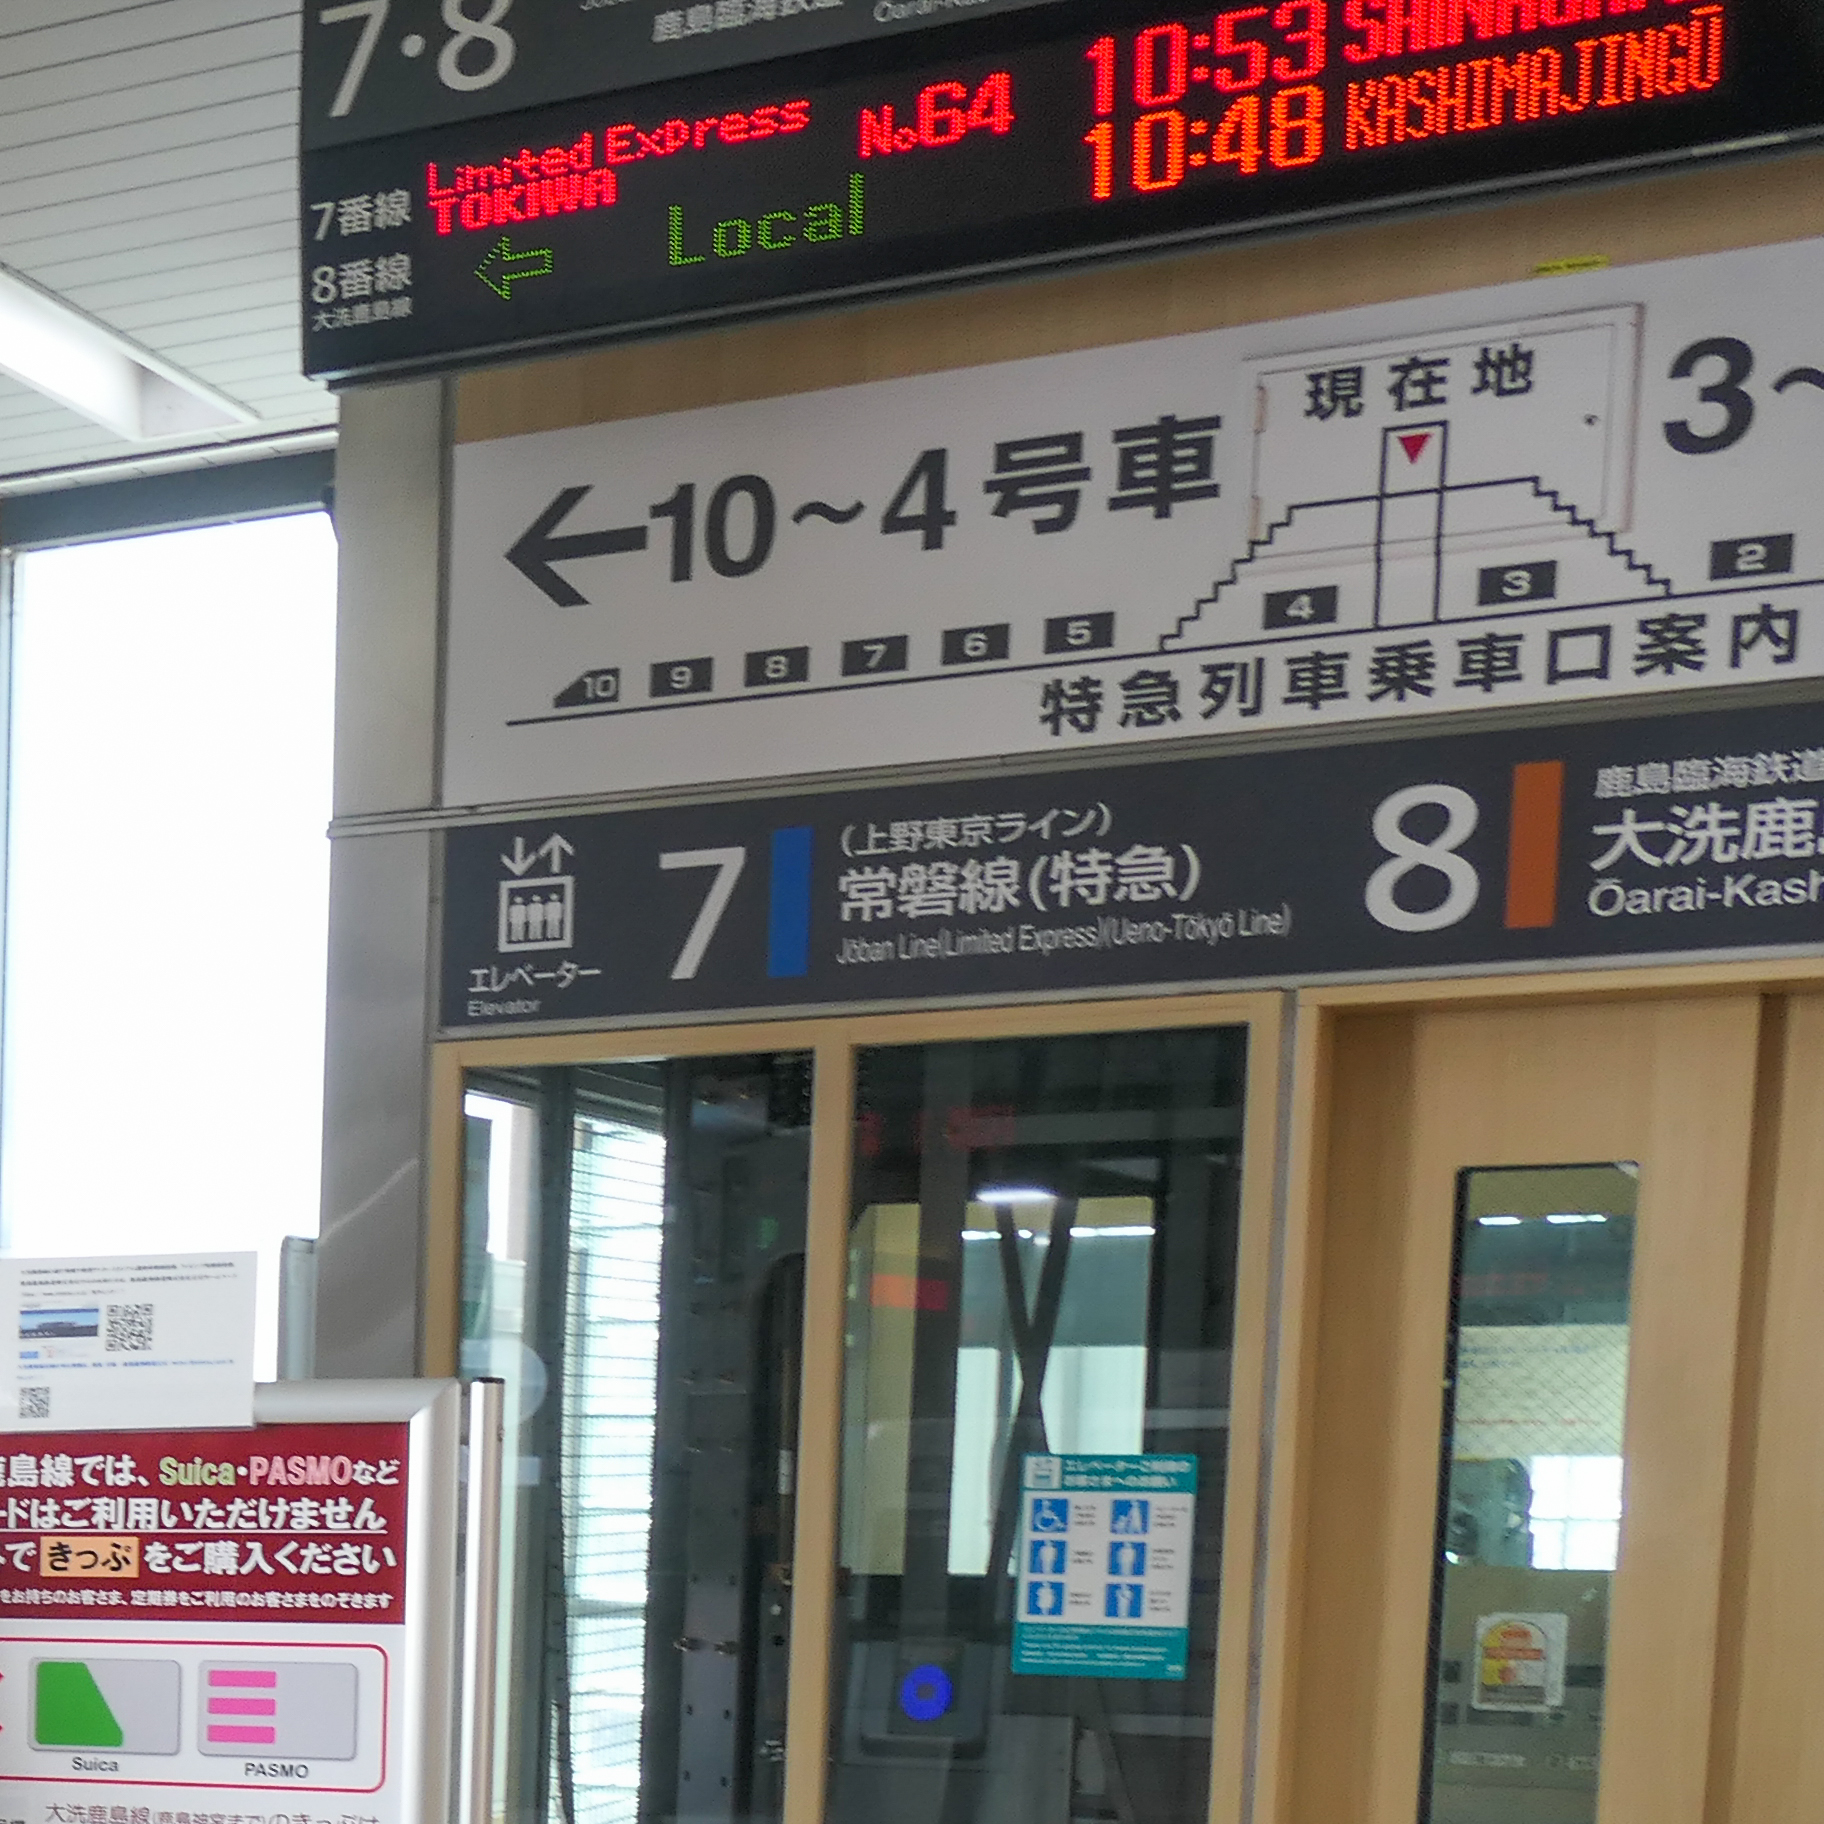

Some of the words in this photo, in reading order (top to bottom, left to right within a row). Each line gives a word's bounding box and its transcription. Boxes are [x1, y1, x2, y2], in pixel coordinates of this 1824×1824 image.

[1085, 0, 1327, 116] 10:53
[427, 131, 593, 196] Limited
[606, 100, 812, 163] Express
[1083, 84, 1325, 201] 10:48
[310, 188, 412, 241] 7番線
[427, 167, 618, 236] TOKIWA
[668, 172, 865, 267] Local
[311, 252, 412, 304] 8番線
[1304, 343, 1535, 420] 現在地
[1736, 543, 1768, 571] 2
[1285, 595, 1314, 620] 4
[1502, 570, 1531, 597] 3
[863, 645, 886, 670] 7
[963, 631, 987, 658] 6
[1065, 620, 1092, 645] 5
[582, 674, 617, 699] 10
[671, 665, 693, 690] 9
[765, 654, 787, 680] 8
[1040, 603, 1800, 736] 特急列車乗車口案内
[1364, 783, 1481, 933] 8
[1590, 797, 1824, 871] 大洗鹿
[838, 843, 1202, 922] 常磐線(特急)
[658, 846, 747, 981] 7
[468, 959, 602, 993] エレベーター
[70, 1755, 120, 1773] Suica
[243, 1761, 310, 1780] PASMO
